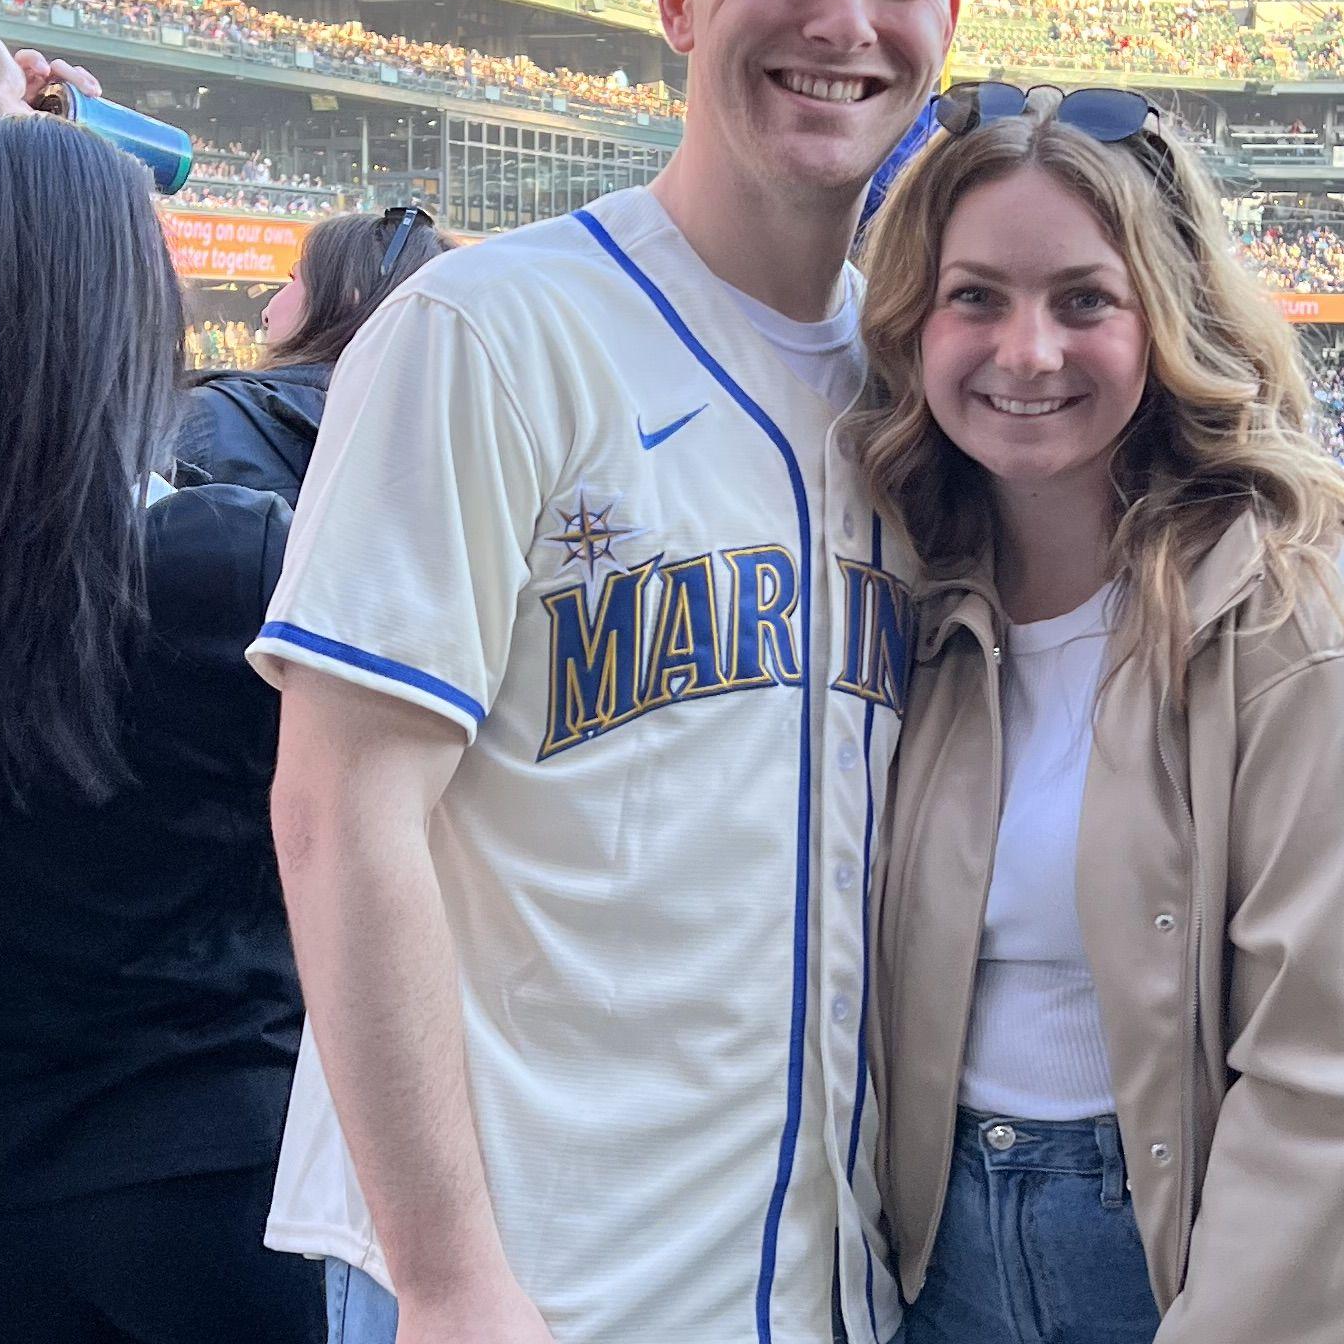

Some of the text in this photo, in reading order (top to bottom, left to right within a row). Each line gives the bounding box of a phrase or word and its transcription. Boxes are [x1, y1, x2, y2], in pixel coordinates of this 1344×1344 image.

[215, 223, 233, 241] on
[237, 224, 261, 243] our
[211, 248, 276, 276] together.
